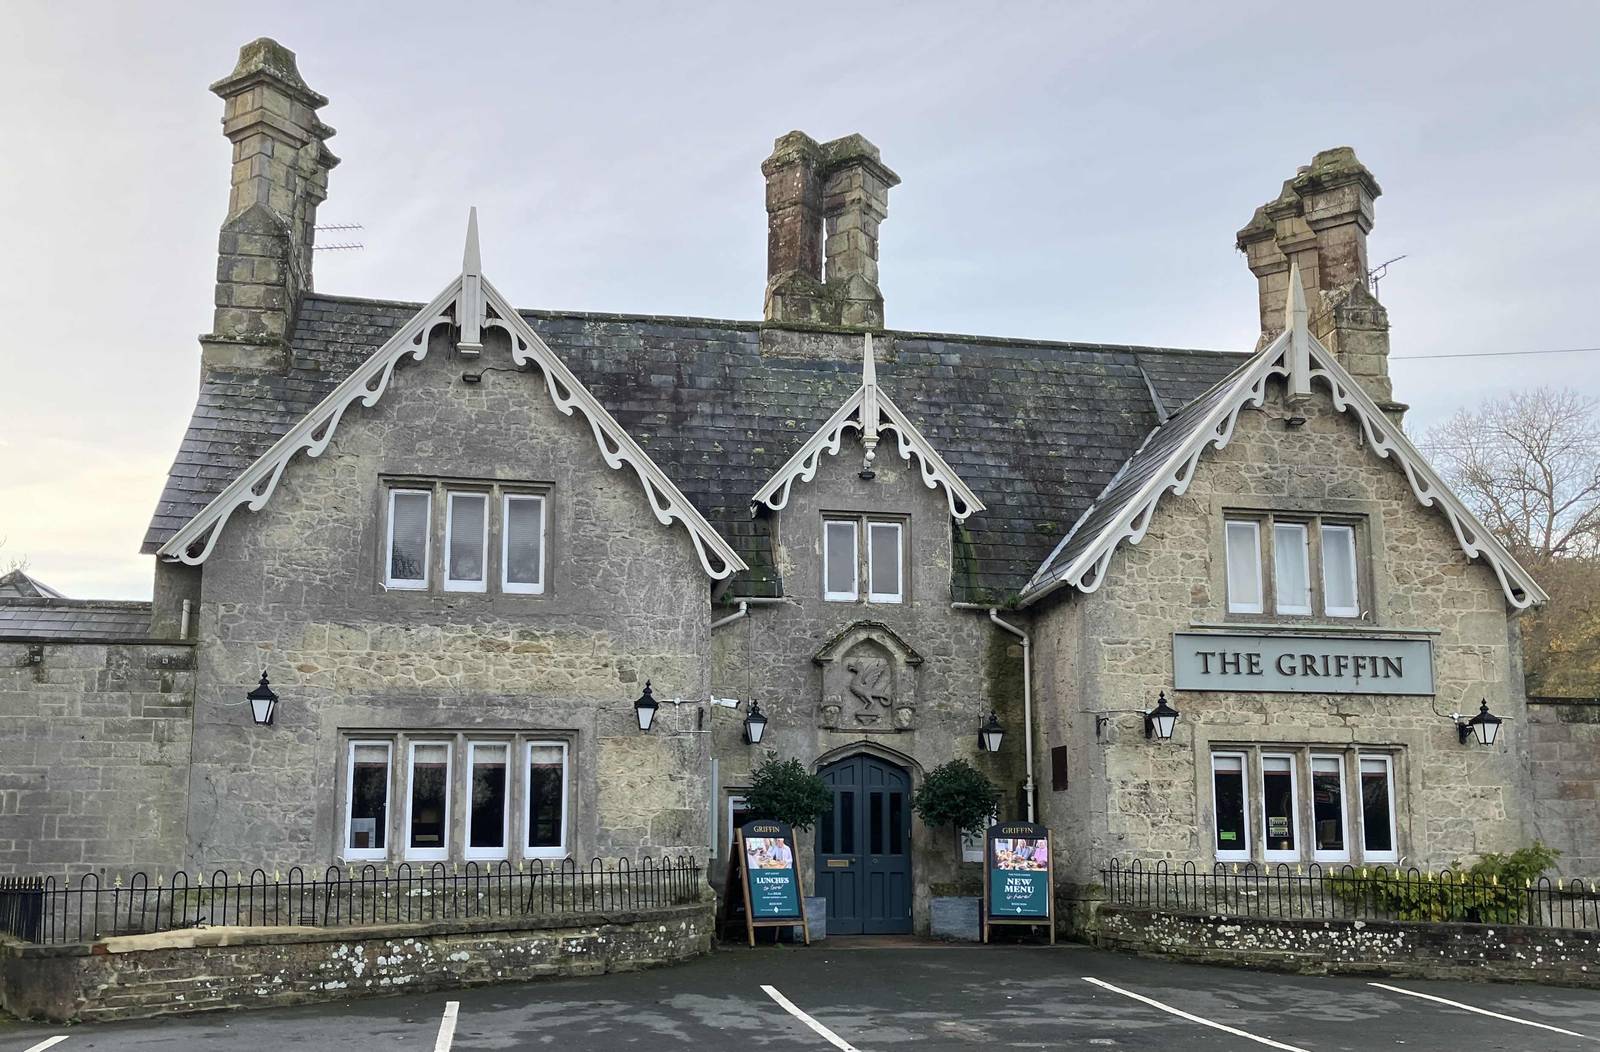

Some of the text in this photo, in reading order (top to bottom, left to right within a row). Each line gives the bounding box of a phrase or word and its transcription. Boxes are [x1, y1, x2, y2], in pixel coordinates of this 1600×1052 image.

[1195, 651, 1404, 679] THE GRIFFIN
[753, 825, 780, 833] GRIFFIN
[1006, 877, 1032, 886] NEW
[1004, 885, 1035, 894] MENU
